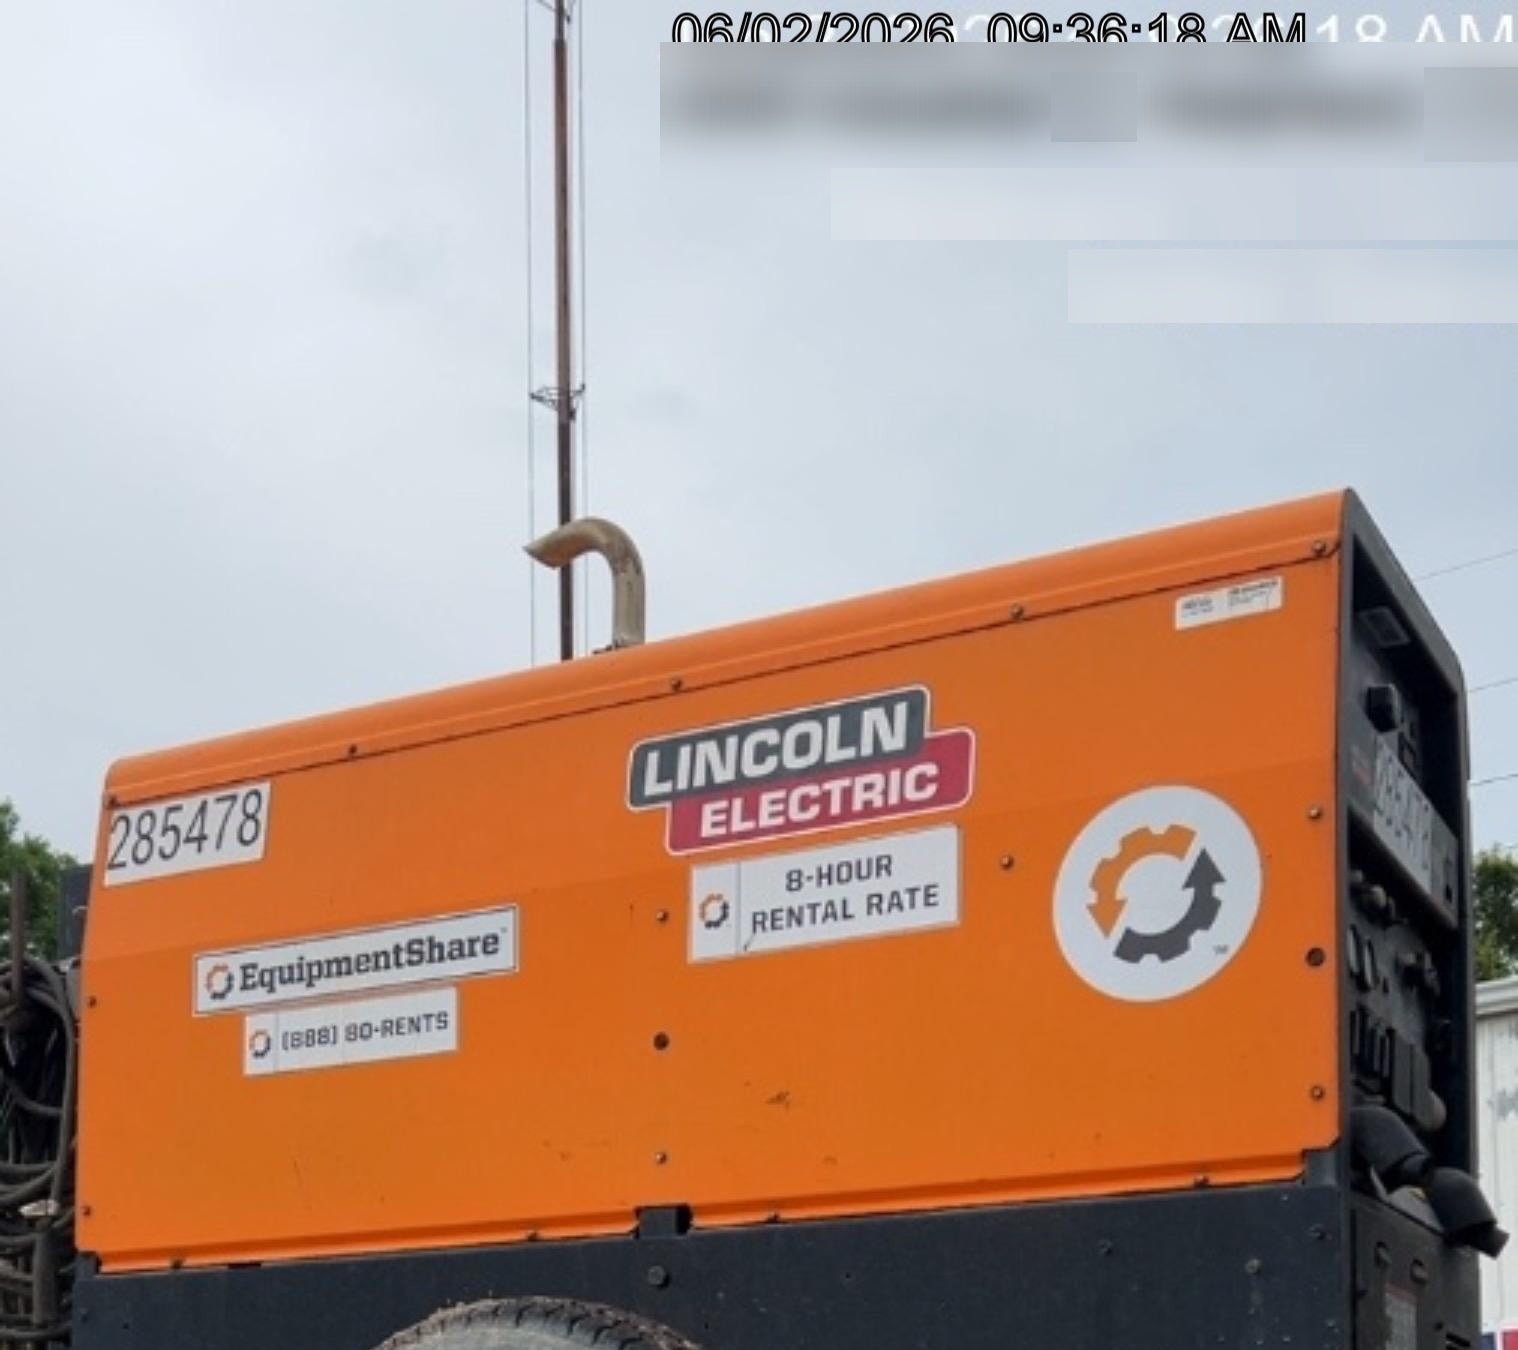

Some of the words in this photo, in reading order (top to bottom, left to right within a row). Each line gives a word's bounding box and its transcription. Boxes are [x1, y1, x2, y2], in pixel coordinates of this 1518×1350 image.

[644, 701, 909, 797] LINCOLN
[107, 787, 263, 870] 285478
[700, 762, 941, 838] ELECTRIC
[785, 854, 893, 892] 8-HOUR
[751, 898, 854, 935] RENTAL
[866, 884, 940, 916] RATE
[239, 931, 501, 994] EquipmentShare
[281, 1024, 338, 1051] (888)
